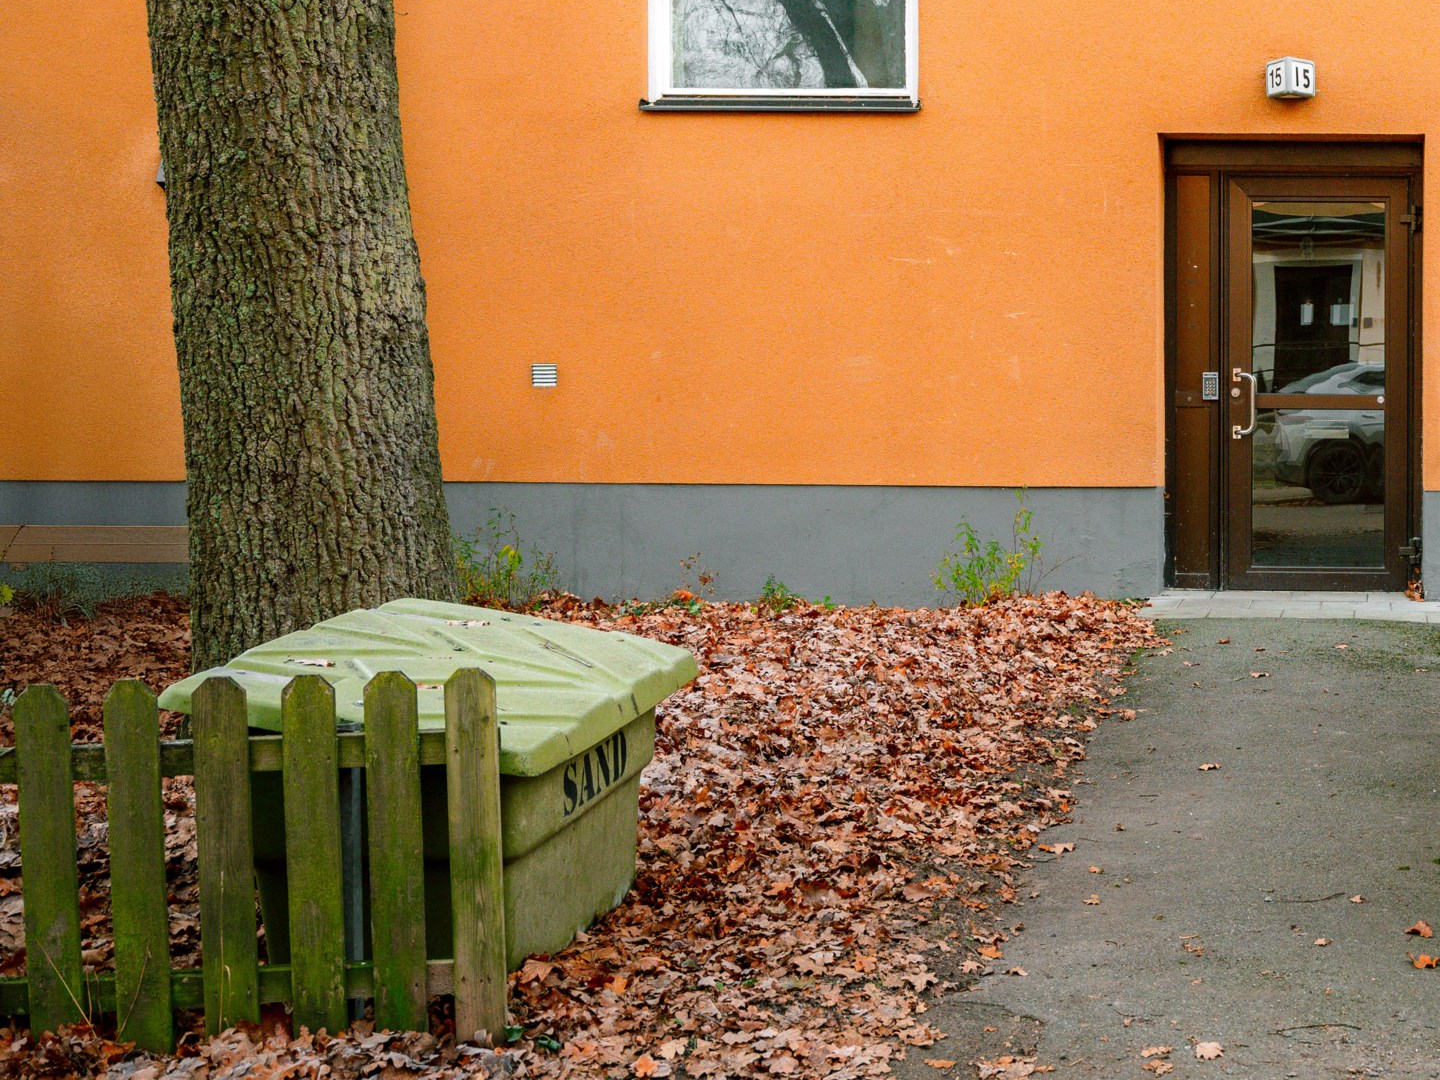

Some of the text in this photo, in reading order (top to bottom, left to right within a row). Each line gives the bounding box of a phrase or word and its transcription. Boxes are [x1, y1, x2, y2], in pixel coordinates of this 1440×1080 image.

[1269, 67, 1282, 88] 15
[1295, 66, 1310, 89] 15
[563, 730, 627, 817] SAND
